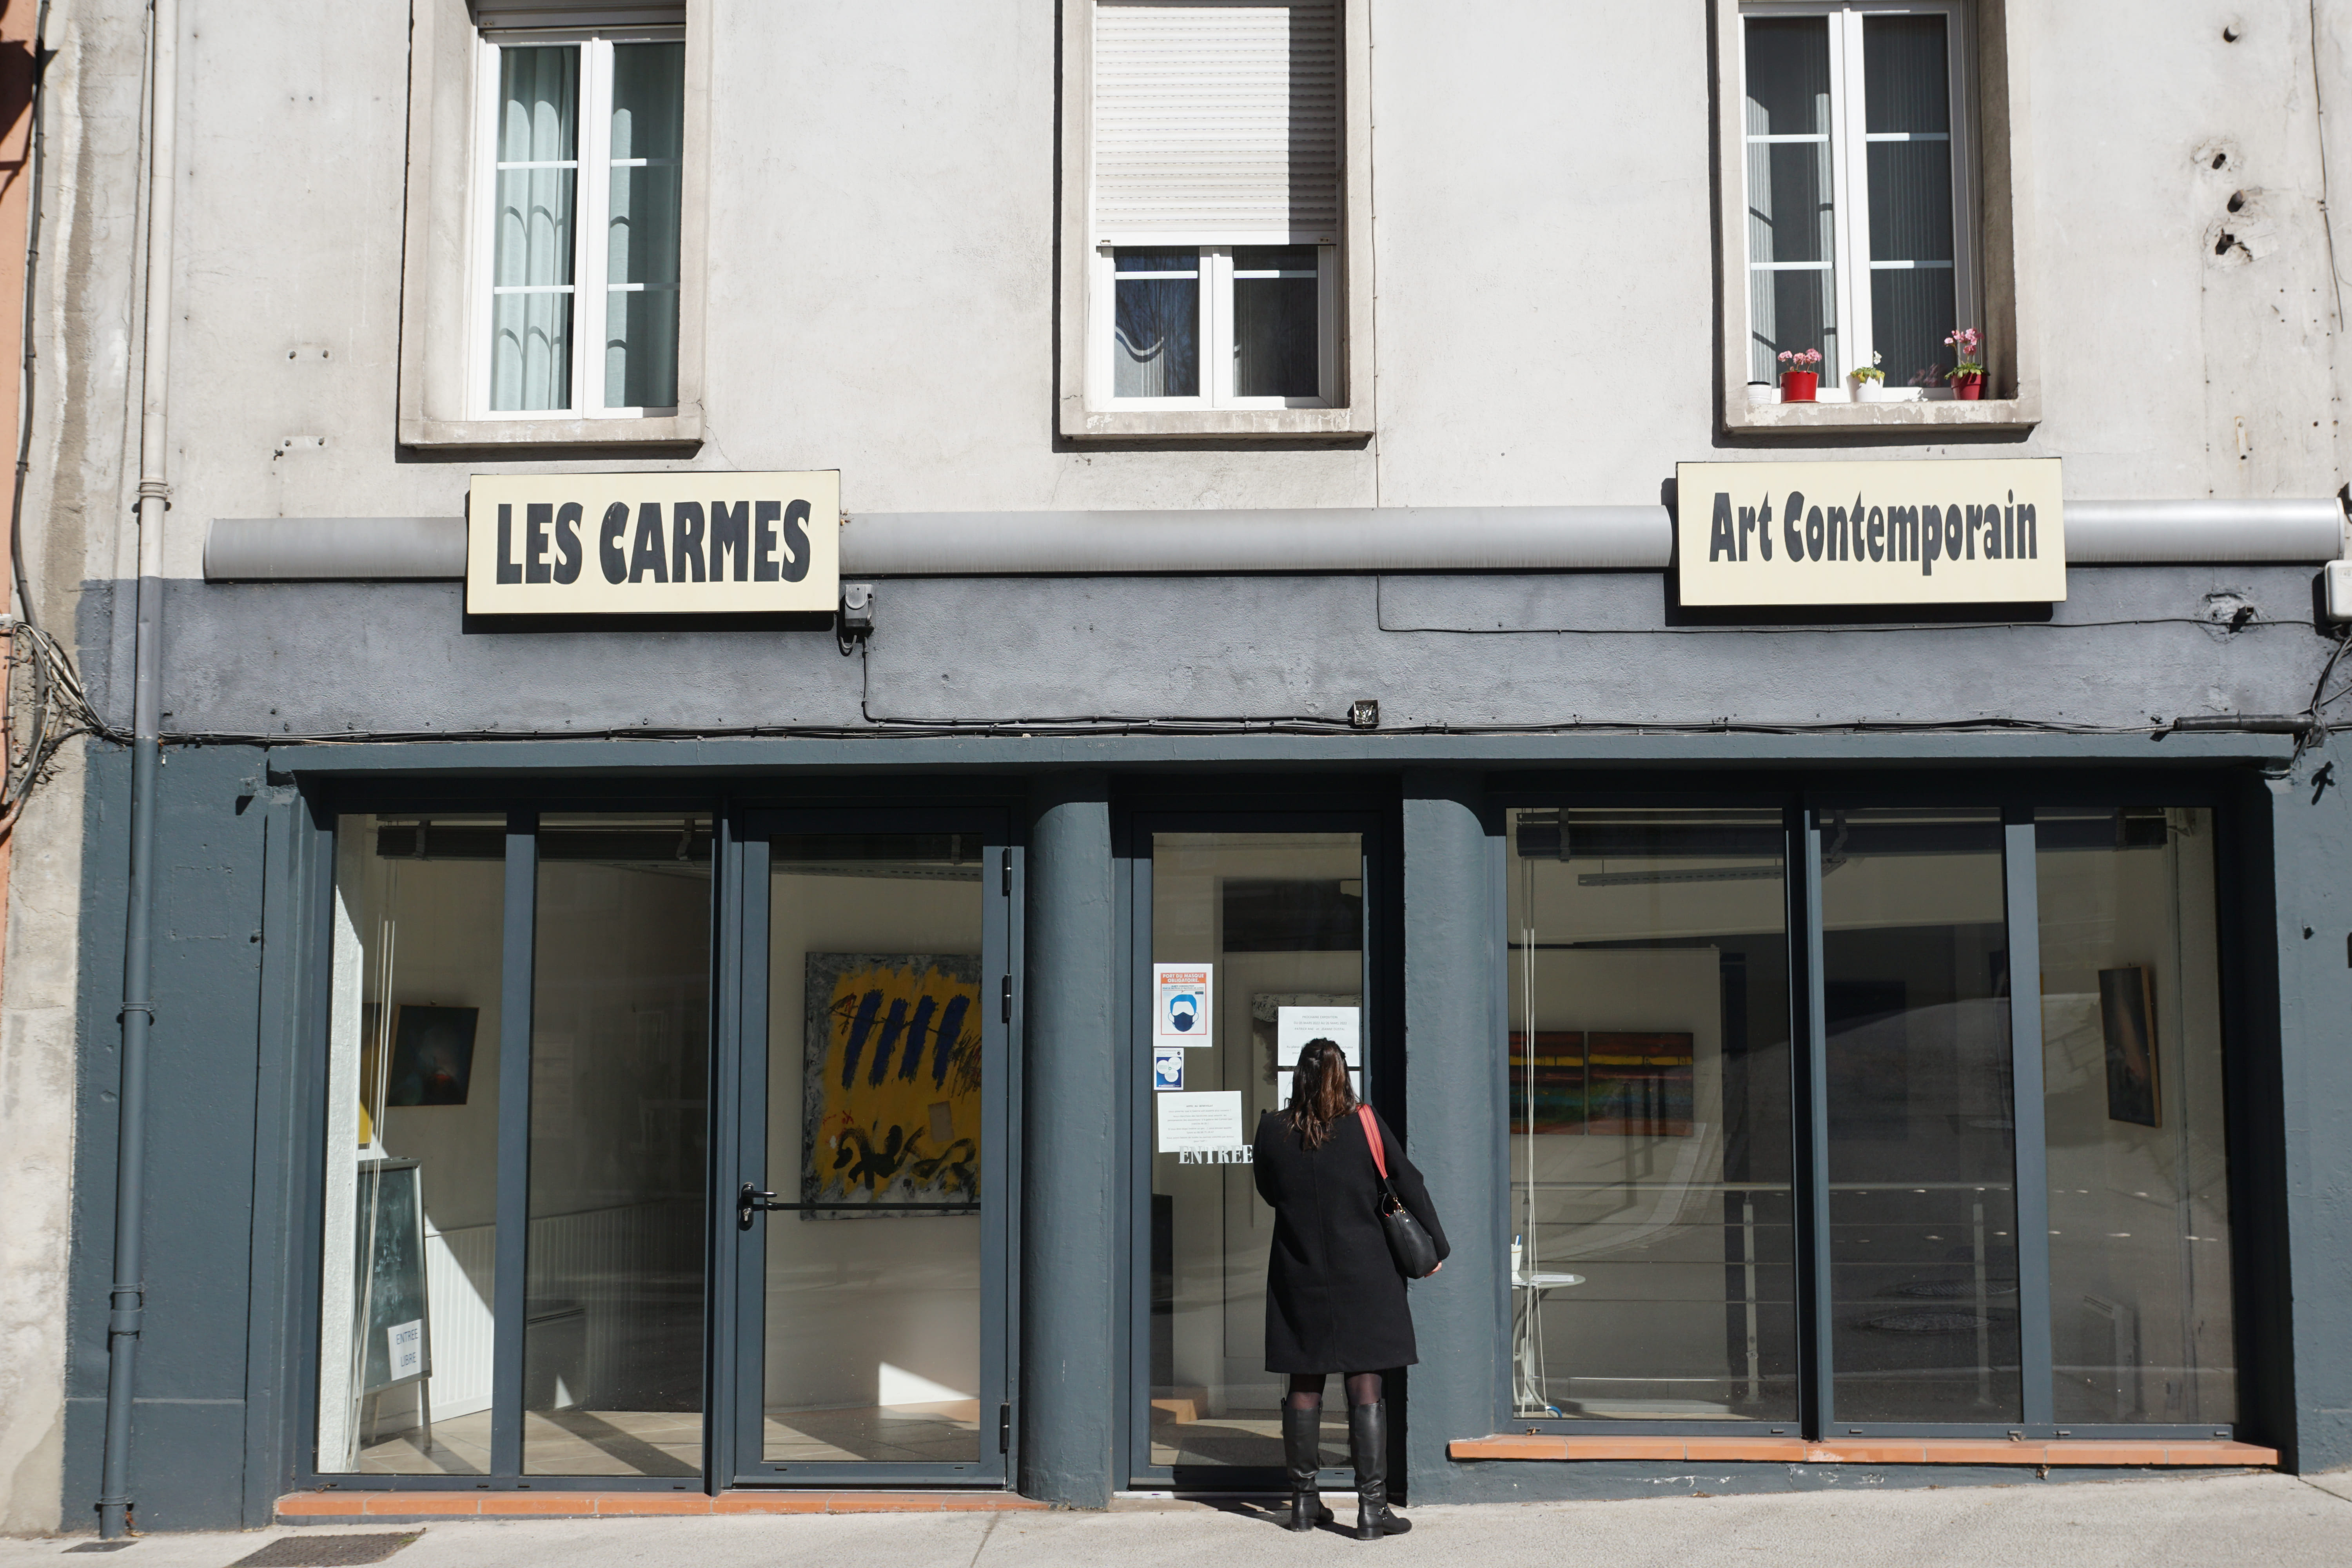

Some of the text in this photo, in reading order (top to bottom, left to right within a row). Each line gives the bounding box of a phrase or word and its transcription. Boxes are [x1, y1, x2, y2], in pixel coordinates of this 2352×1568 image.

[496, 499, 811, 585] LES CARMES
[1709, 489, 2037, 576] Art Contemporain
[1179, 1145, 1253, 1164] ENTREE
[396, 1328, 418, 1345] ENTREE
[401, 1352, 416, 1367] LIBRE
